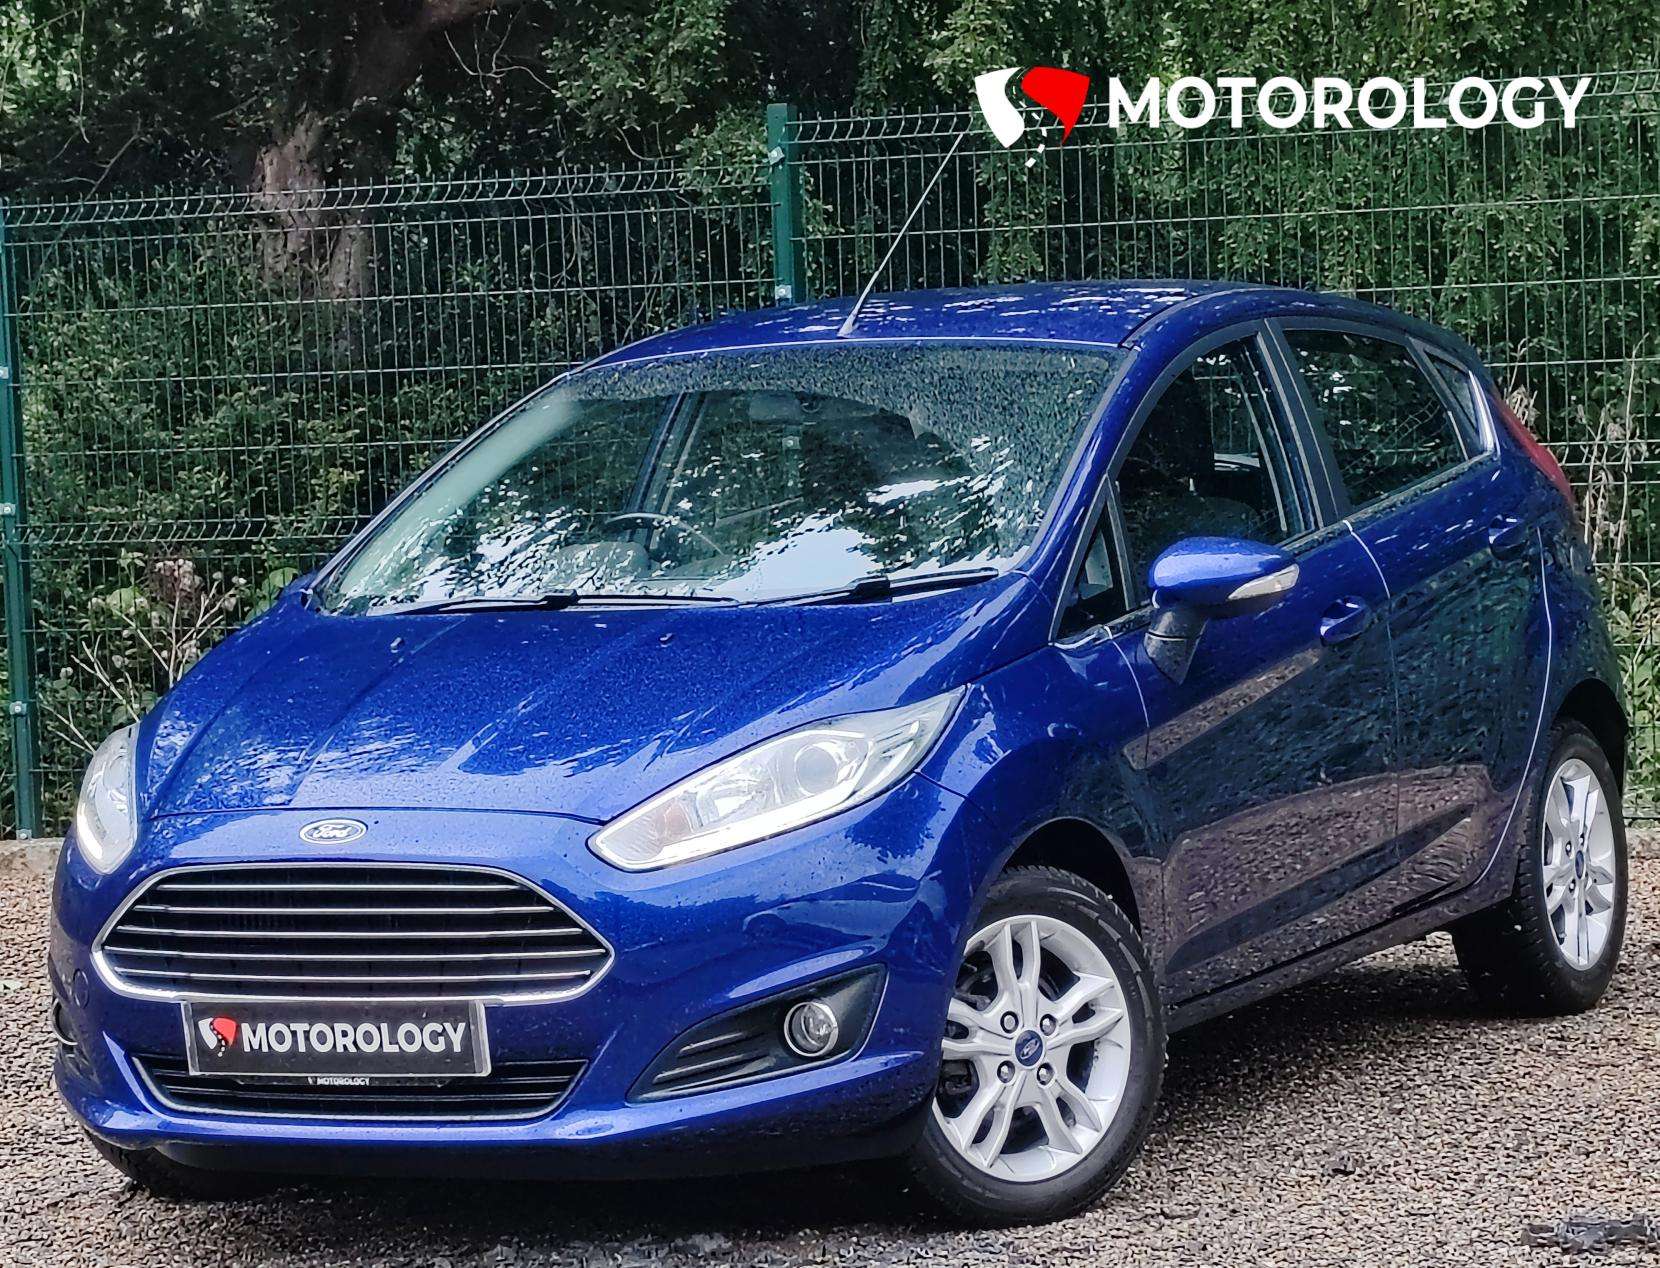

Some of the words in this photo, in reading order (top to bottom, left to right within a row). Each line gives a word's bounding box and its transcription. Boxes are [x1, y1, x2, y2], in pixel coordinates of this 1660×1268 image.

[312, 824, 353, 838] Ford
[241, 1022, 466, 1053] MOTOROLOGY
[316, 1077, 370, 1086] MOTOROLOGY
